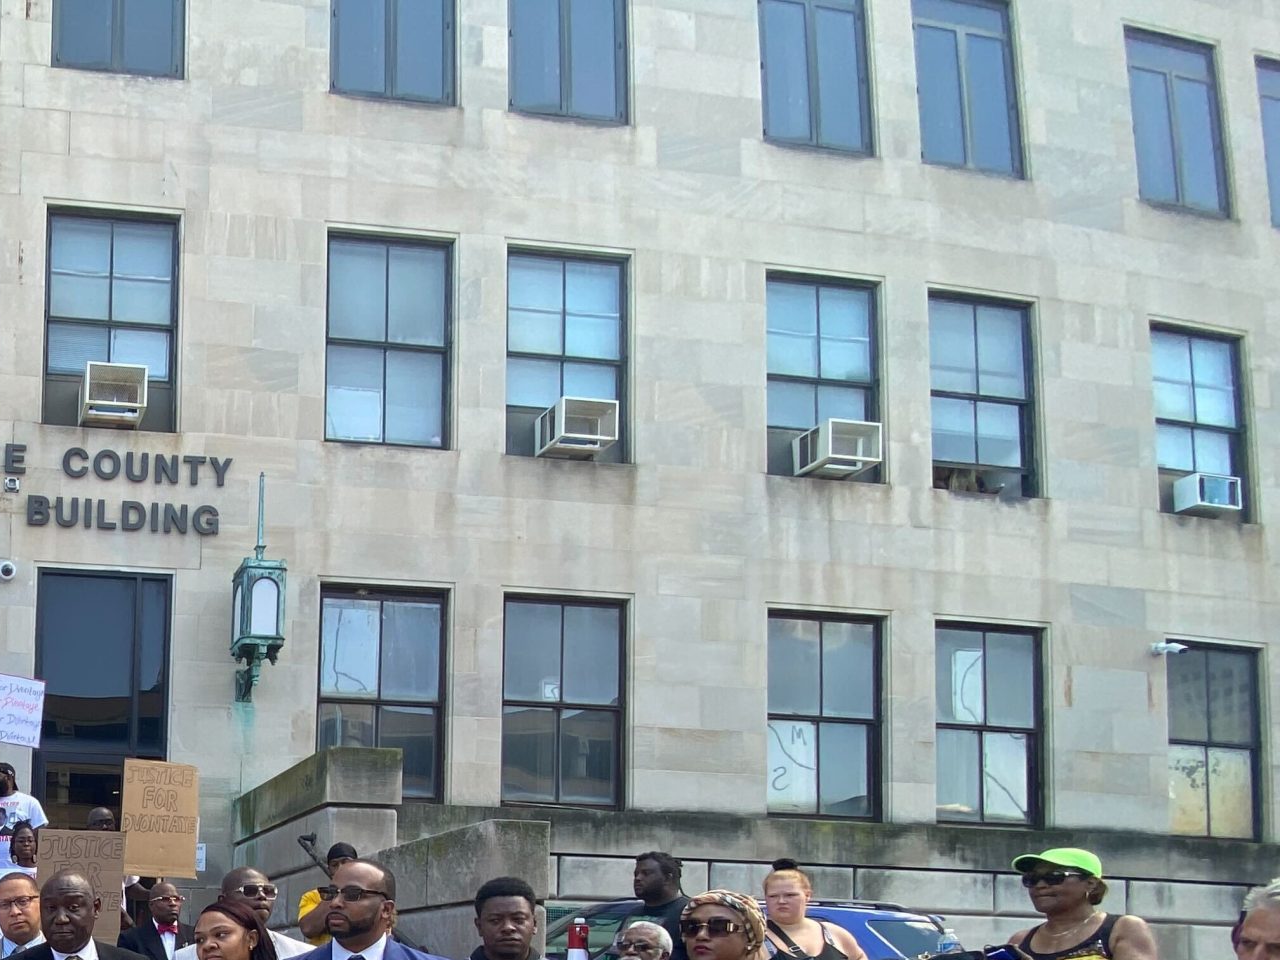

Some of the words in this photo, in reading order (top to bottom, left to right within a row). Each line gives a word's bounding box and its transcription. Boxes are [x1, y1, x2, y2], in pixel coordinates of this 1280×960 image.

[62, 447, 234, 487] COUNTY
[26, 494, 220, 535] BUILDING
[126, 765, 195, 788] JUSTICE
[142, 786, 179, 812] FOR
[122, 812, 197, 835] DVONTAYE
[40, 834, 125, 860] JUSTICE
